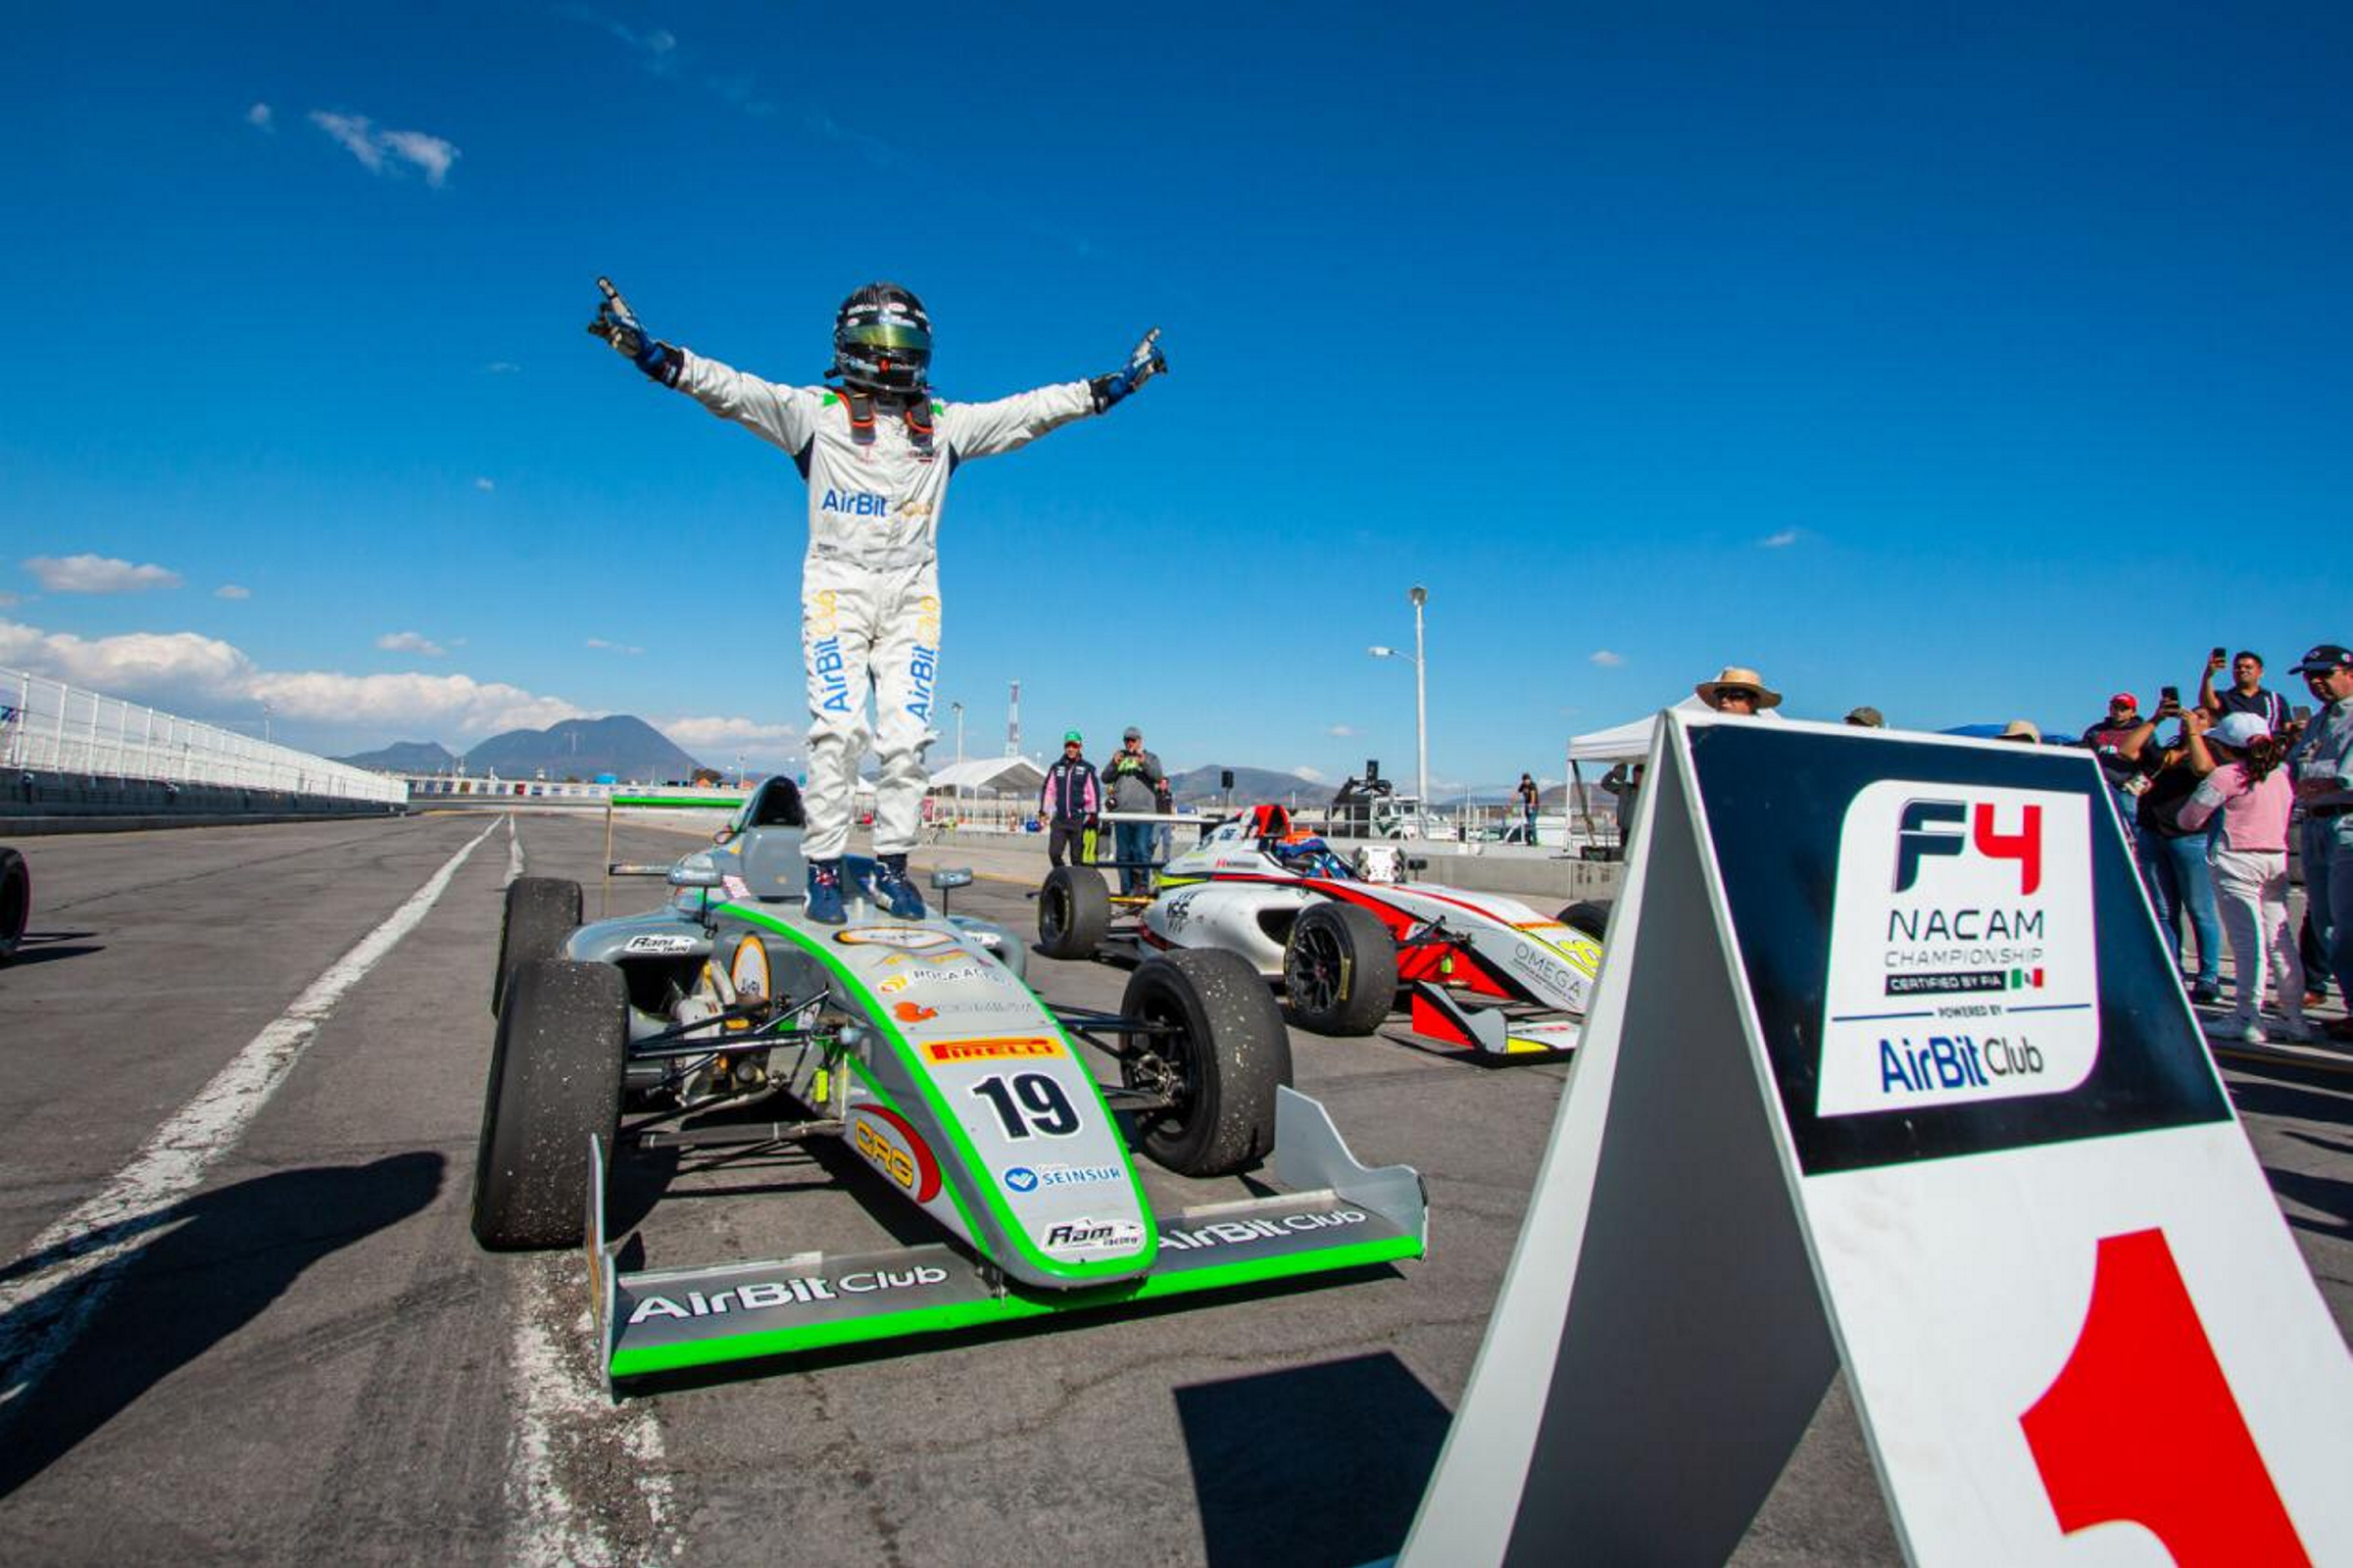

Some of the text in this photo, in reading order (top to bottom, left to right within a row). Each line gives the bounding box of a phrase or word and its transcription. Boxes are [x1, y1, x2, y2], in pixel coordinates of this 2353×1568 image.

[822, 490, 887, 517] AirBit
[813, 636, 852, 713] AirBit
[906, 644, 936, 722] AirBit
[1892, 798, 2041, 896] F4
[1887, 909, 2042, 942] NACAM
[1515, 942, 1581, 997] OMEGA
[1885, 949, 2042, 968] CHAMPIONSHIP
[1890, 975, 2002, 991] CERTIFIED BY FIA
[1938, 1004, 2002, 1018] POWERED BY
[930, 1039, 1054, 1060] PIRELLI
[1879, 1034, 2043, 1093] AirBit Club
[972, 1073, 1080, 1139] 19
[855, 1120, 915, 1189] CRG
[1042, 1167, 1121, 1186] SEINSUR
[1047, 1225, 1114, 1246] Ram
[1282, 1209, 1367, 1231] Club
[627, 1265, 949, 1323] AirBit Club
[2019, 1227, 2315, 1568] 1
